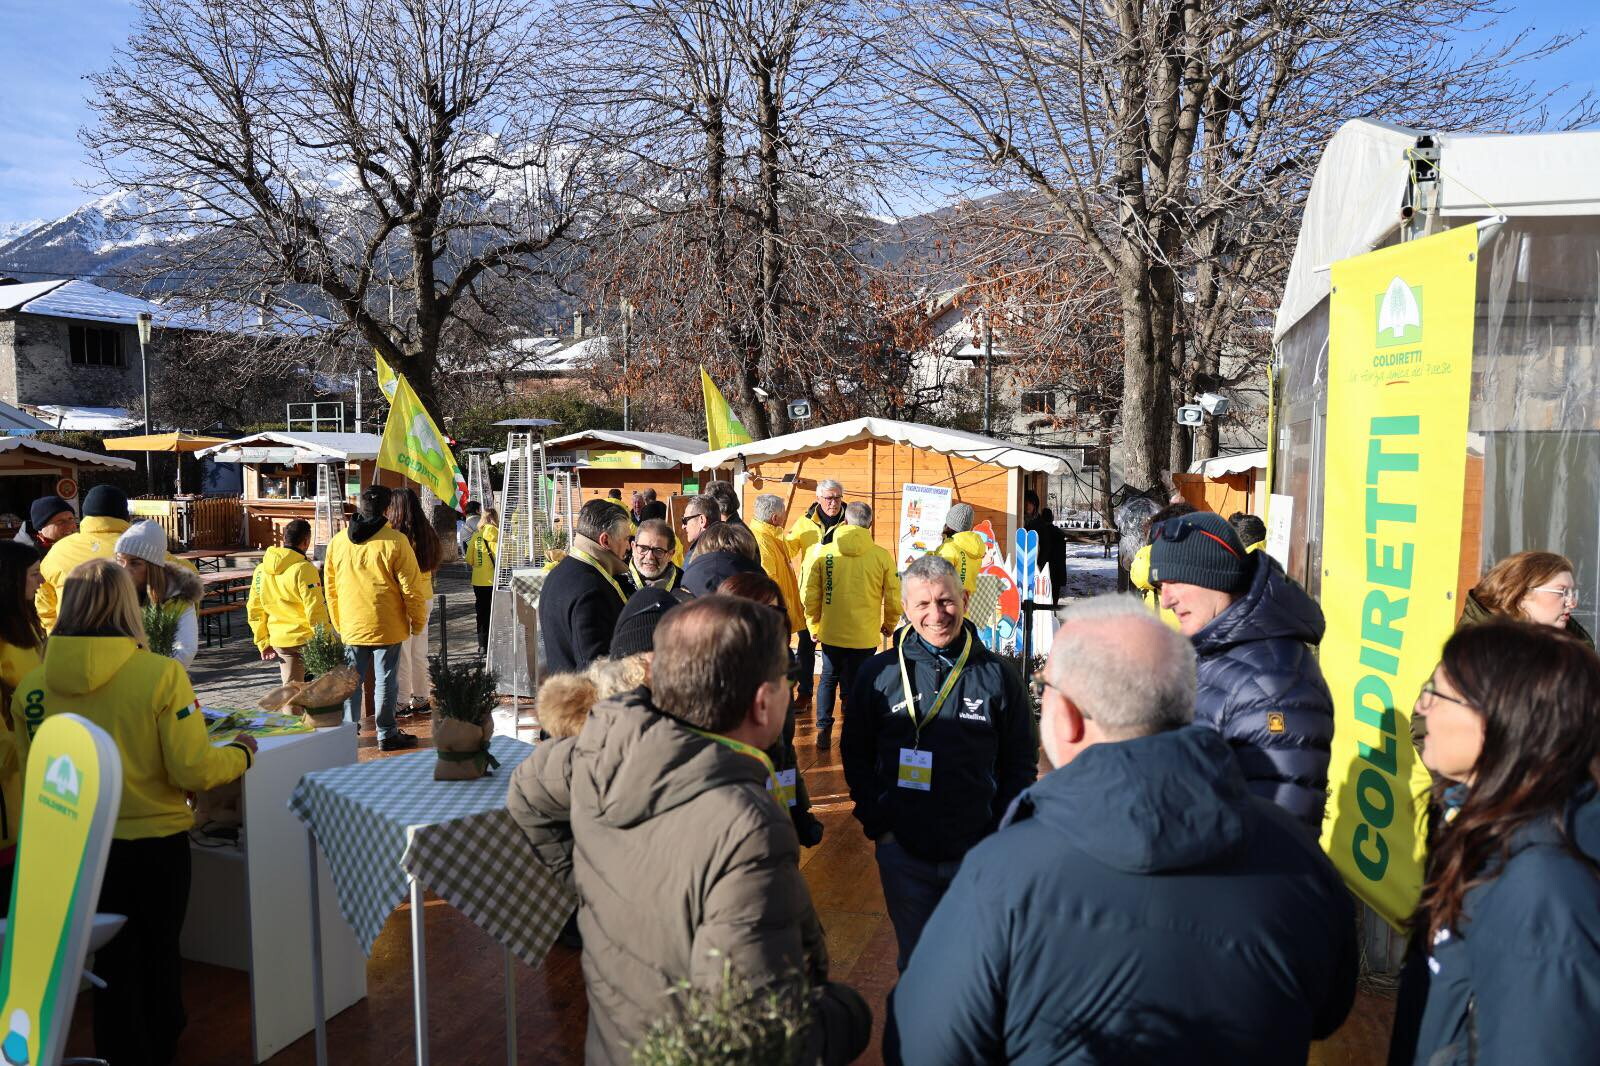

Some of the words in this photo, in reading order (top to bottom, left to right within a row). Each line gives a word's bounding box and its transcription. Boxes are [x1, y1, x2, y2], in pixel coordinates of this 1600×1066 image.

[1373, 350, 1422, 367] COLDIRETTI
[825, 554, 834, 605] COLDIRETTI
[1352, 415, 1420, 882] COLDIRETTI
